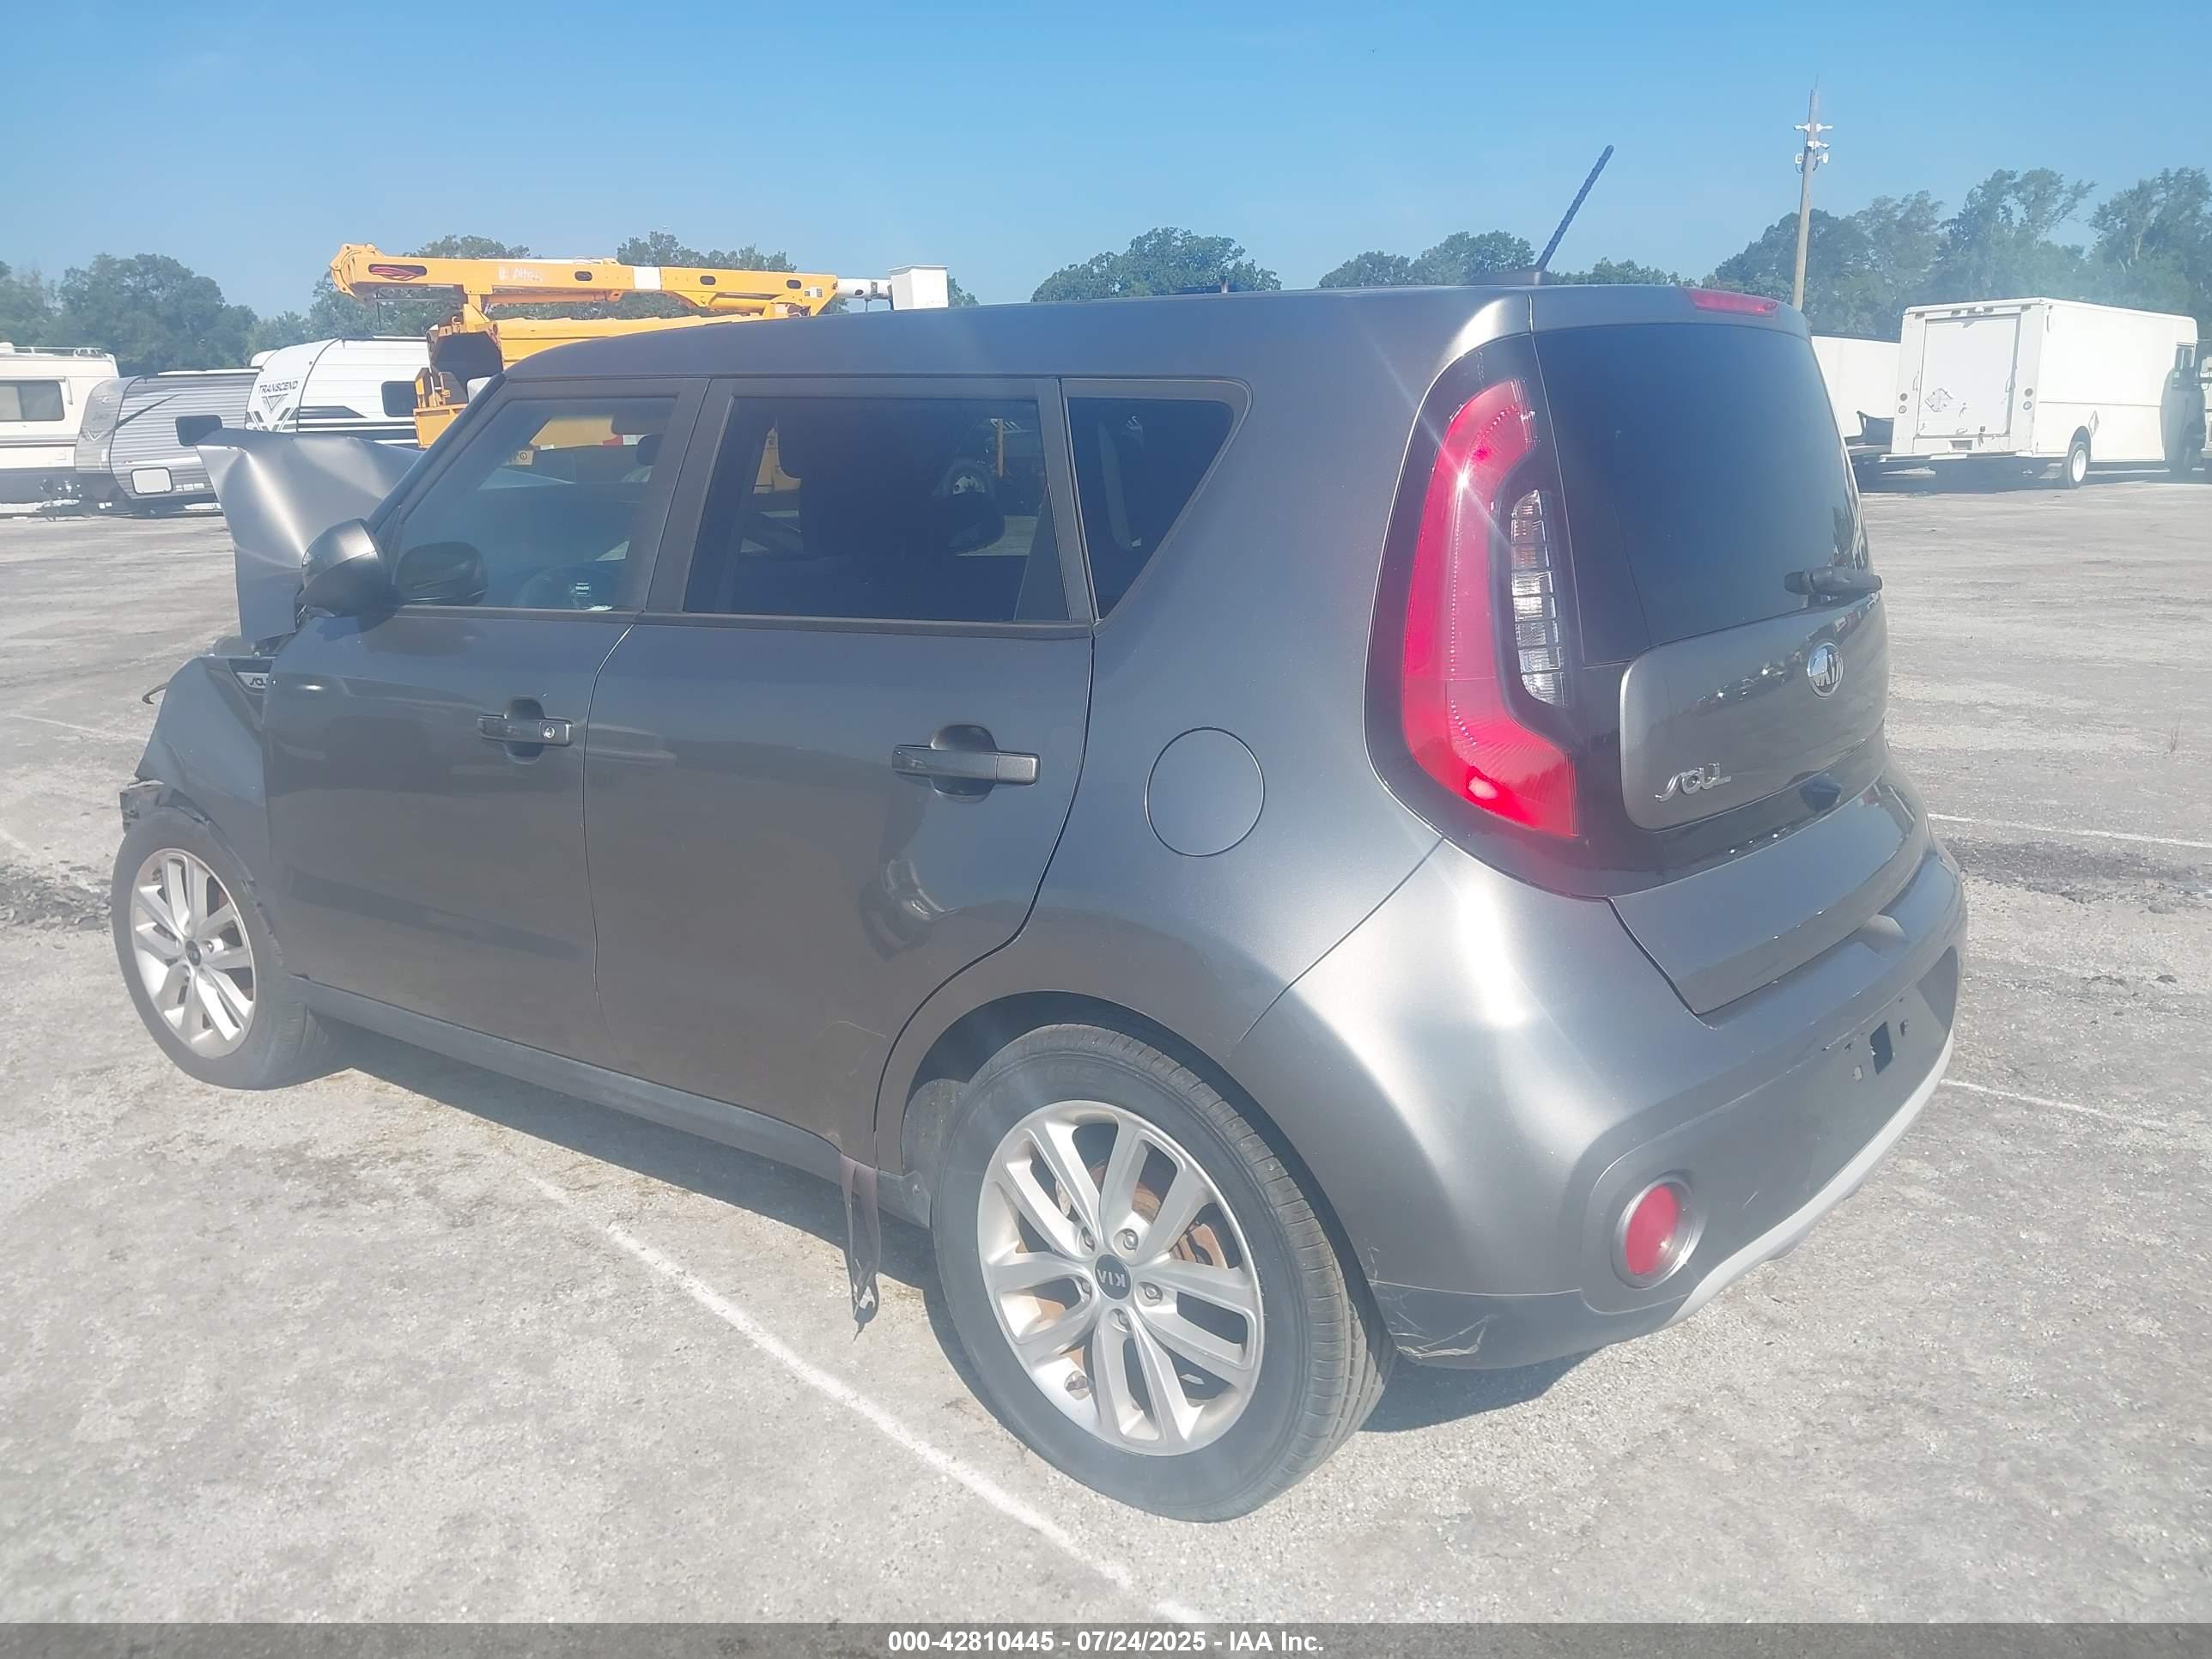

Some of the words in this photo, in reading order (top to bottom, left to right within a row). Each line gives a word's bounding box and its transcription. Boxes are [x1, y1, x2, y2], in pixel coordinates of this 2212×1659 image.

[259, 380, 299, 393] TRANSCEND
[1655, 763, 1732, 802] SOUL
[1097, 1269, 1127, 1288] KIA
